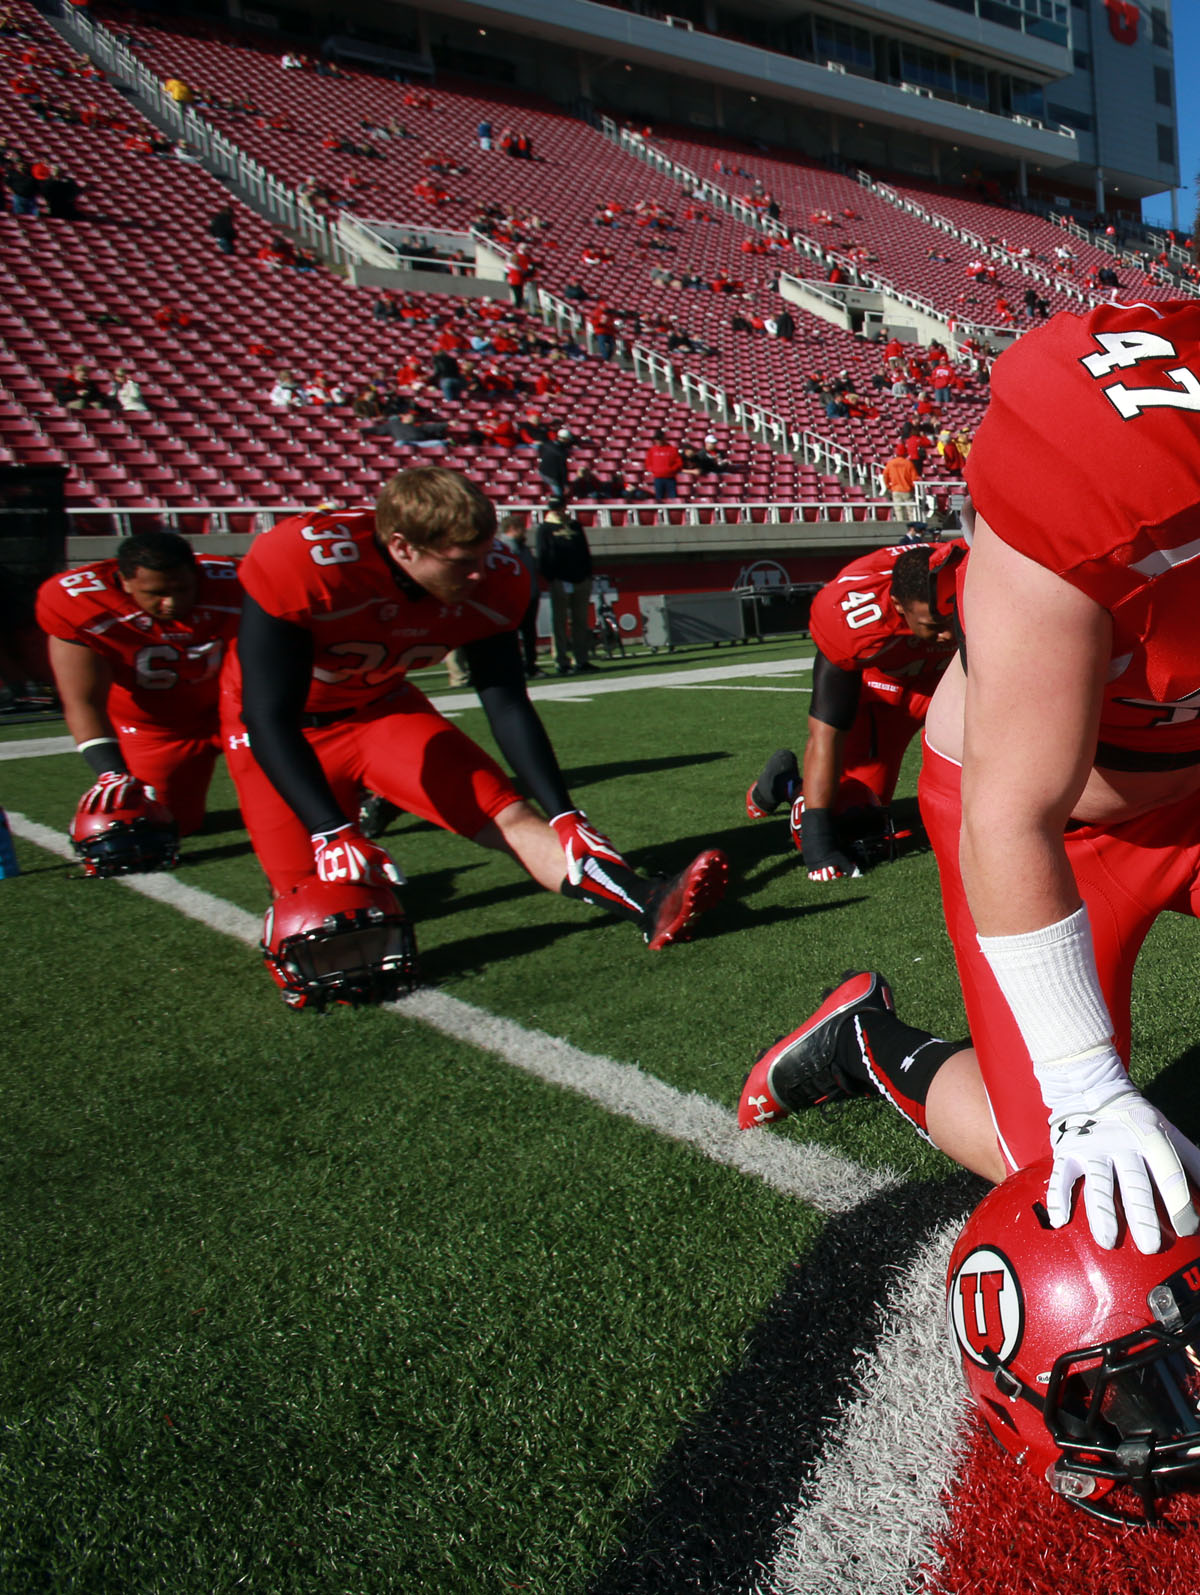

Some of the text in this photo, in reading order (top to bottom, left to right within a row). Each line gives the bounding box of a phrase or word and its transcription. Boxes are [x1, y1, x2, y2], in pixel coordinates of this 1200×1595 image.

[1104, 0, 1140, 47] U
[301, 523, 361, 567] 39
[58, 570, 108, 598] 67
[840, 590, 884, 631] 40
[959, 1269, 1006, 1356] U
